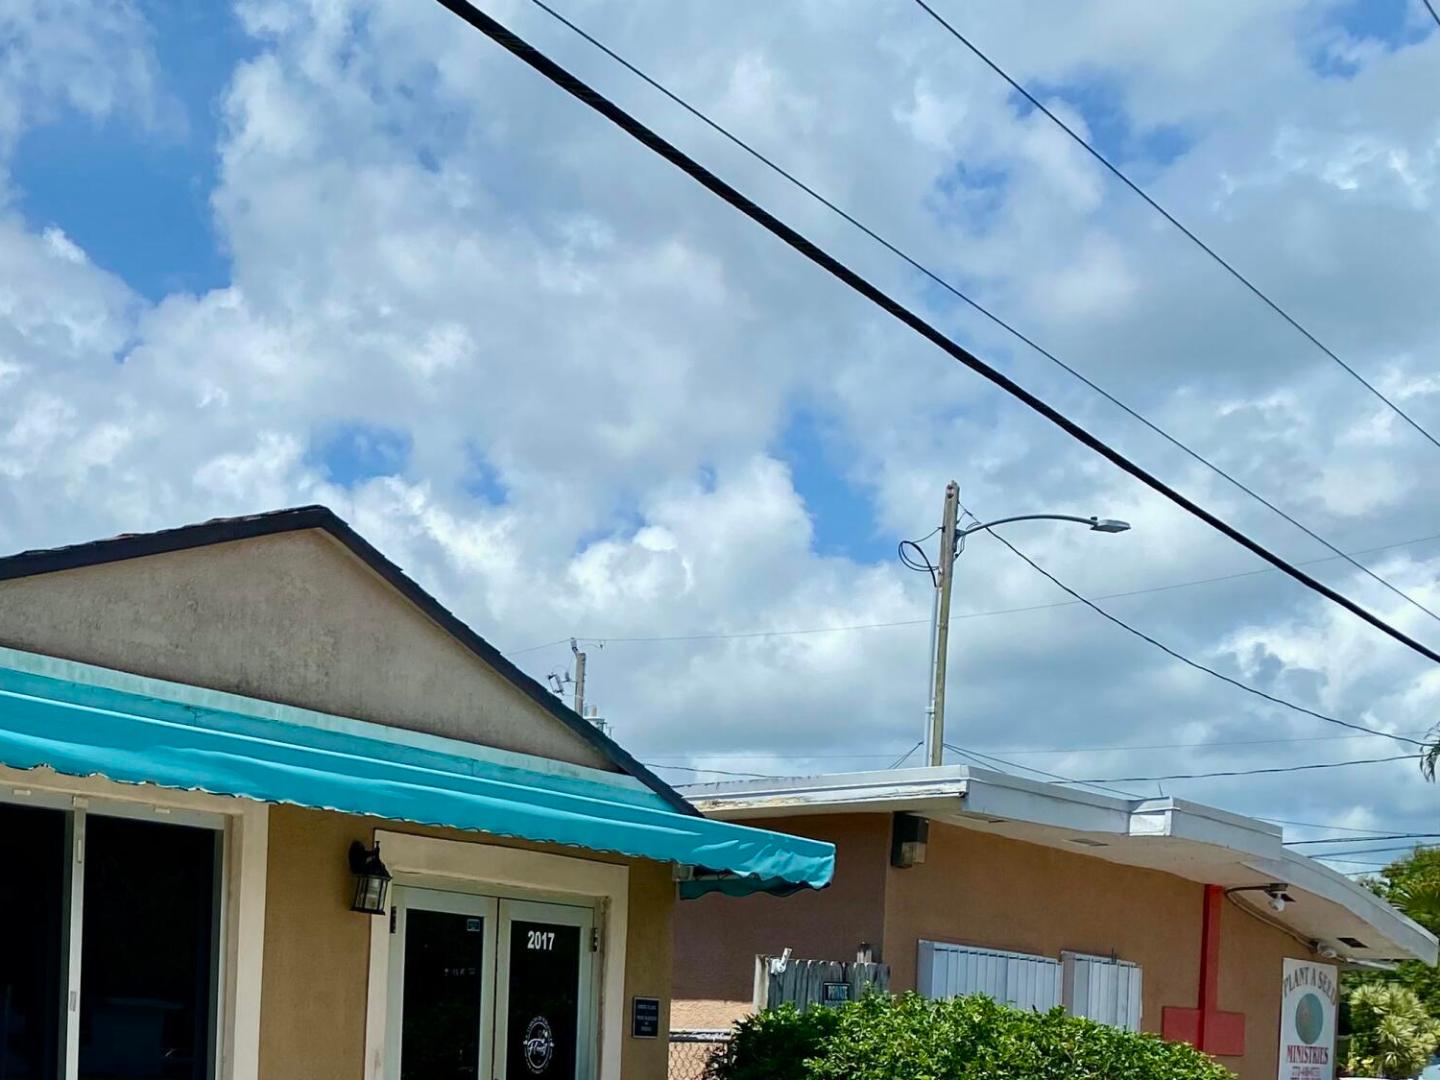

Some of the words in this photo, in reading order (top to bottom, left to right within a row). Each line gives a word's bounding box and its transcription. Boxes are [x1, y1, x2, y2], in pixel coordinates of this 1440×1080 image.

[527, 930, 555, 950] 2017
[1284, 967, 1309, 999] PLANT
[1311, 967, 1317, 987] A
[1287, 1045, 1329, 1065] MINISTRIES
